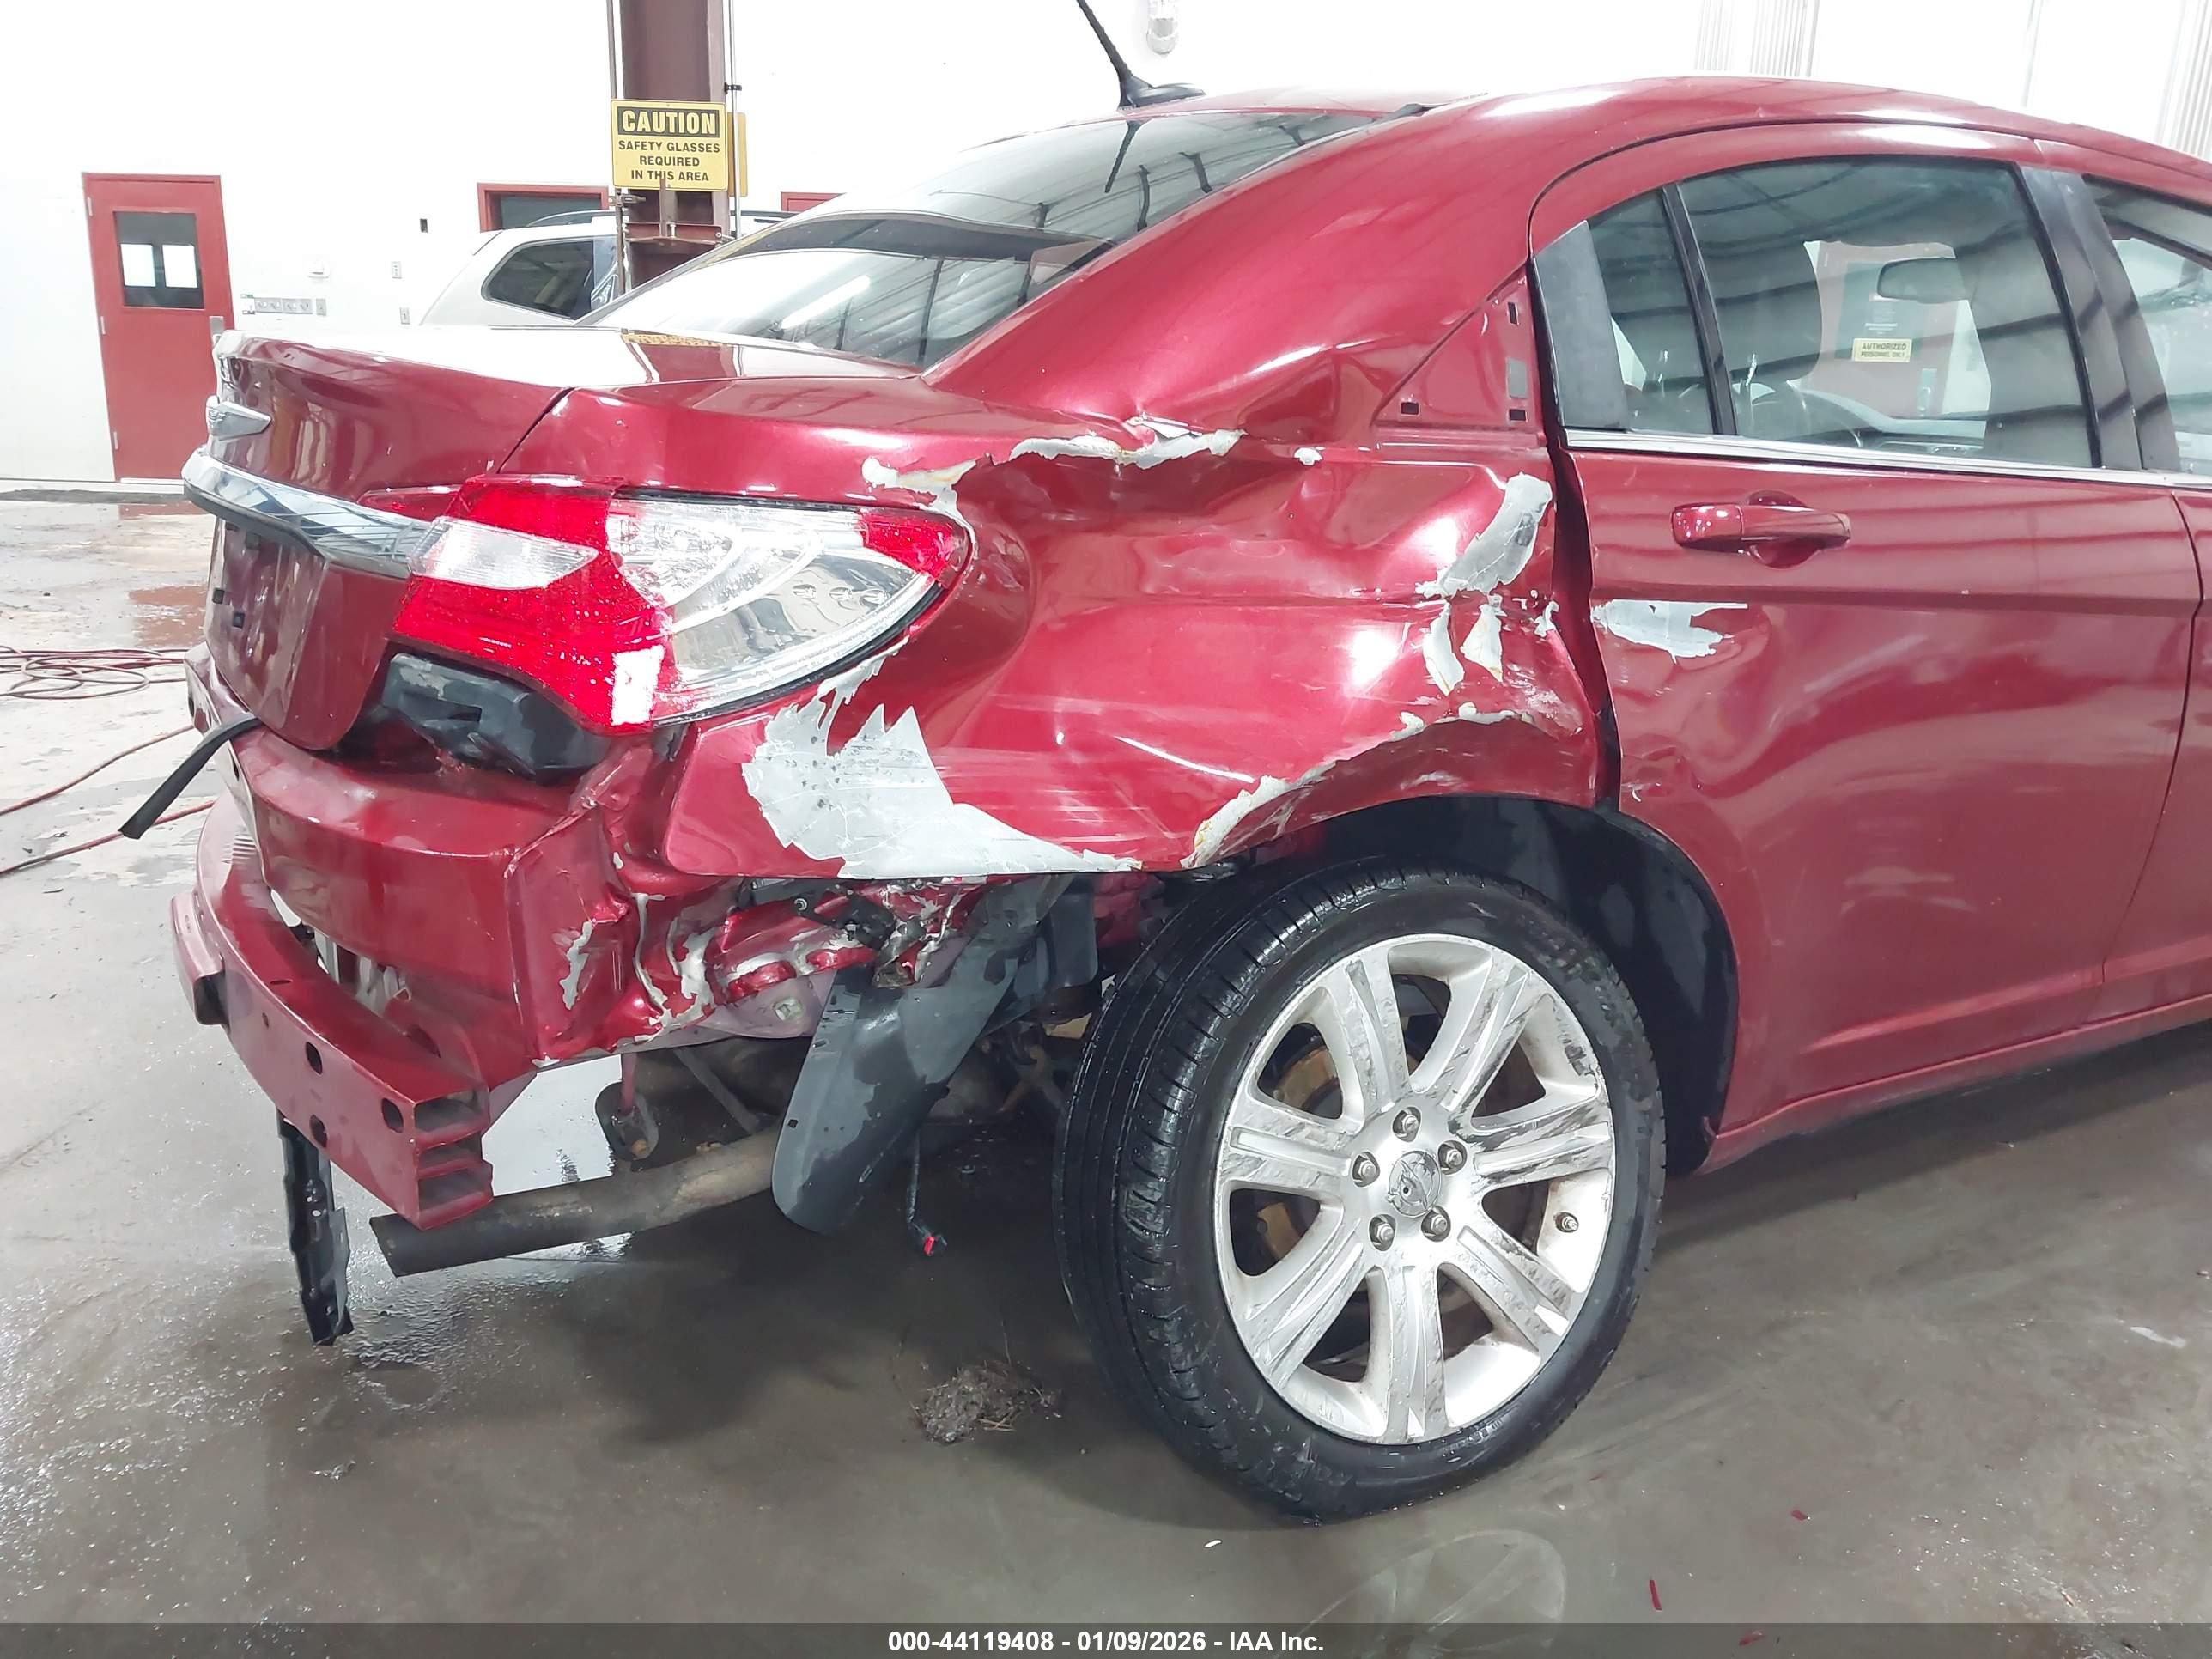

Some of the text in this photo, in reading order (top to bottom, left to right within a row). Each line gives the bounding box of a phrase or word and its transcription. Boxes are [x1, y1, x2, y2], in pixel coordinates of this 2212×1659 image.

[622, 110, 716, 135] CAUTION
[618, 140, 720, 153] SAFETY GLASSES
[639, 155, 700, 167] REQUIRED
[631, 170, 709, 181] IN THIS AREA
